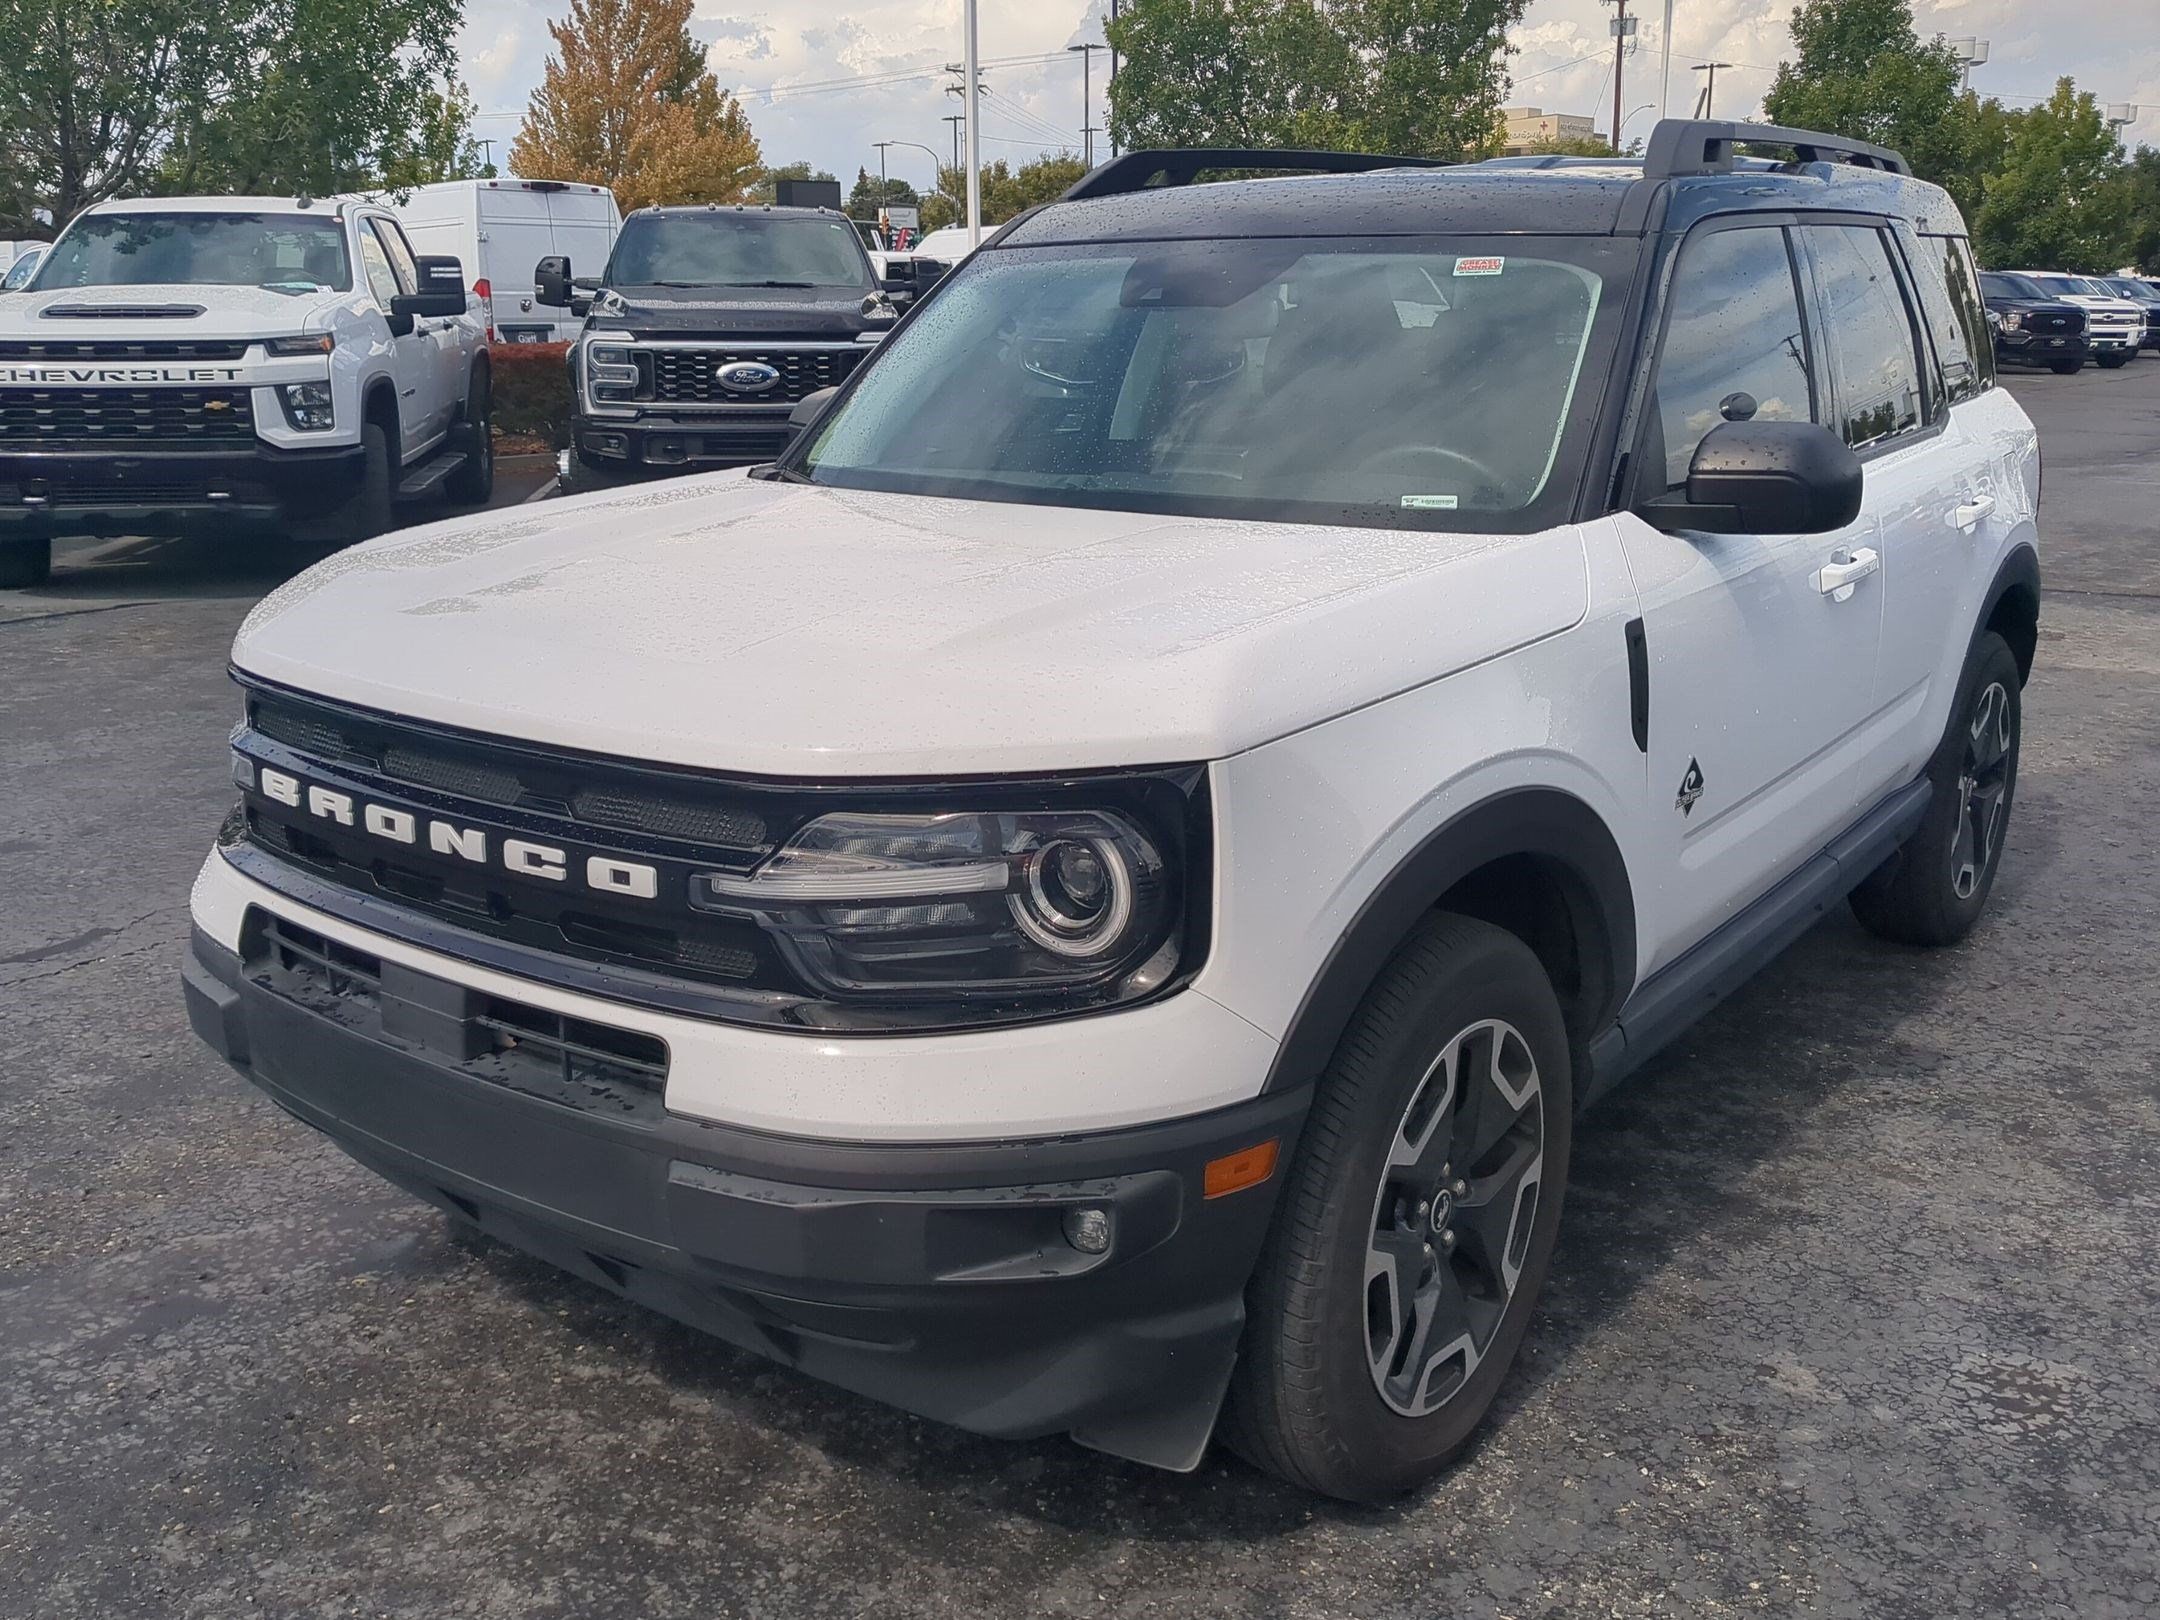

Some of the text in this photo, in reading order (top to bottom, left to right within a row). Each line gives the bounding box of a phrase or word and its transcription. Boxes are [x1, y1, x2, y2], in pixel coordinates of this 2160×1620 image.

[0, 369, 244, 382] HEVROLET
[733, 369, 763, 382] Ford
[261, 767, 658, 899] BRONCO
